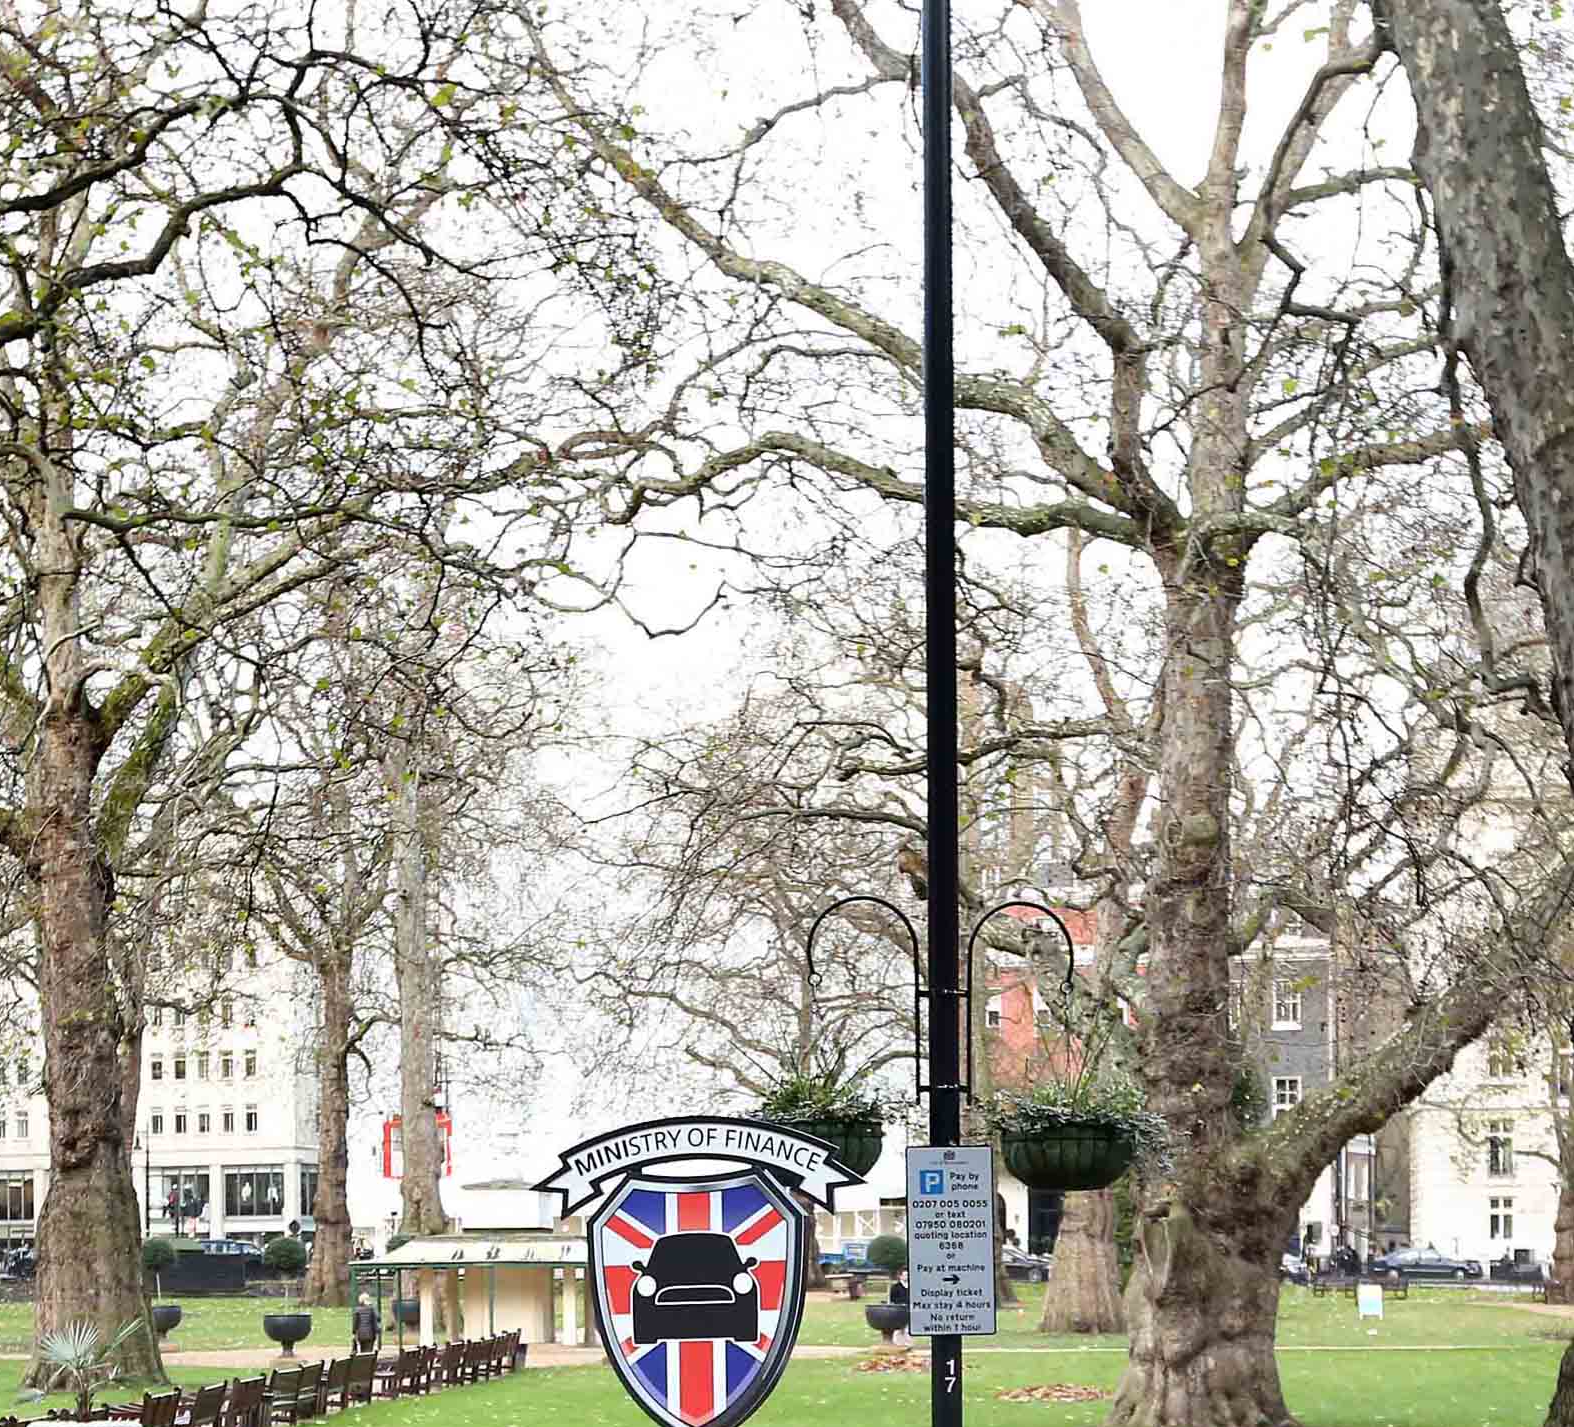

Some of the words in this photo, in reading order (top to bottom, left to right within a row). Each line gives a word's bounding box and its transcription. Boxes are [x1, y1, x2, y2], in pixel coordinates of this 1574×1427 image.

[574, 1129, 682, 1176] MINISTRY
[688, 1127, 718, 1147] OF
[725, 1129, 822, 1172] FINANCE
[949, 1172, 966, 1181] Pay
[968, 1172, 979, 1182] by
[925, 1173, 940, 1193] P
[951, 1183, 978, 1192] phone
[912, 1200, 937, 1208] 0207
[914, 1231, 949, 1240] quoting
[951, 1230, 987, 1239] location
[917, 1264, 933, 1273] Pay
[936, 1264, 946, 1272] at
[948, 1264, 985, 1272] machine
[921, 1289, 953, 1298] Display
[956, 1288, 982, 1296] ticket
[934, 1301, 953, 1310] stay
[966, 1301, 991, 1309] hours
[930, 1313, 943, 1321] No
[923, 1324, 952, 1332] within
[961, 1323, 981, 1332] hour
